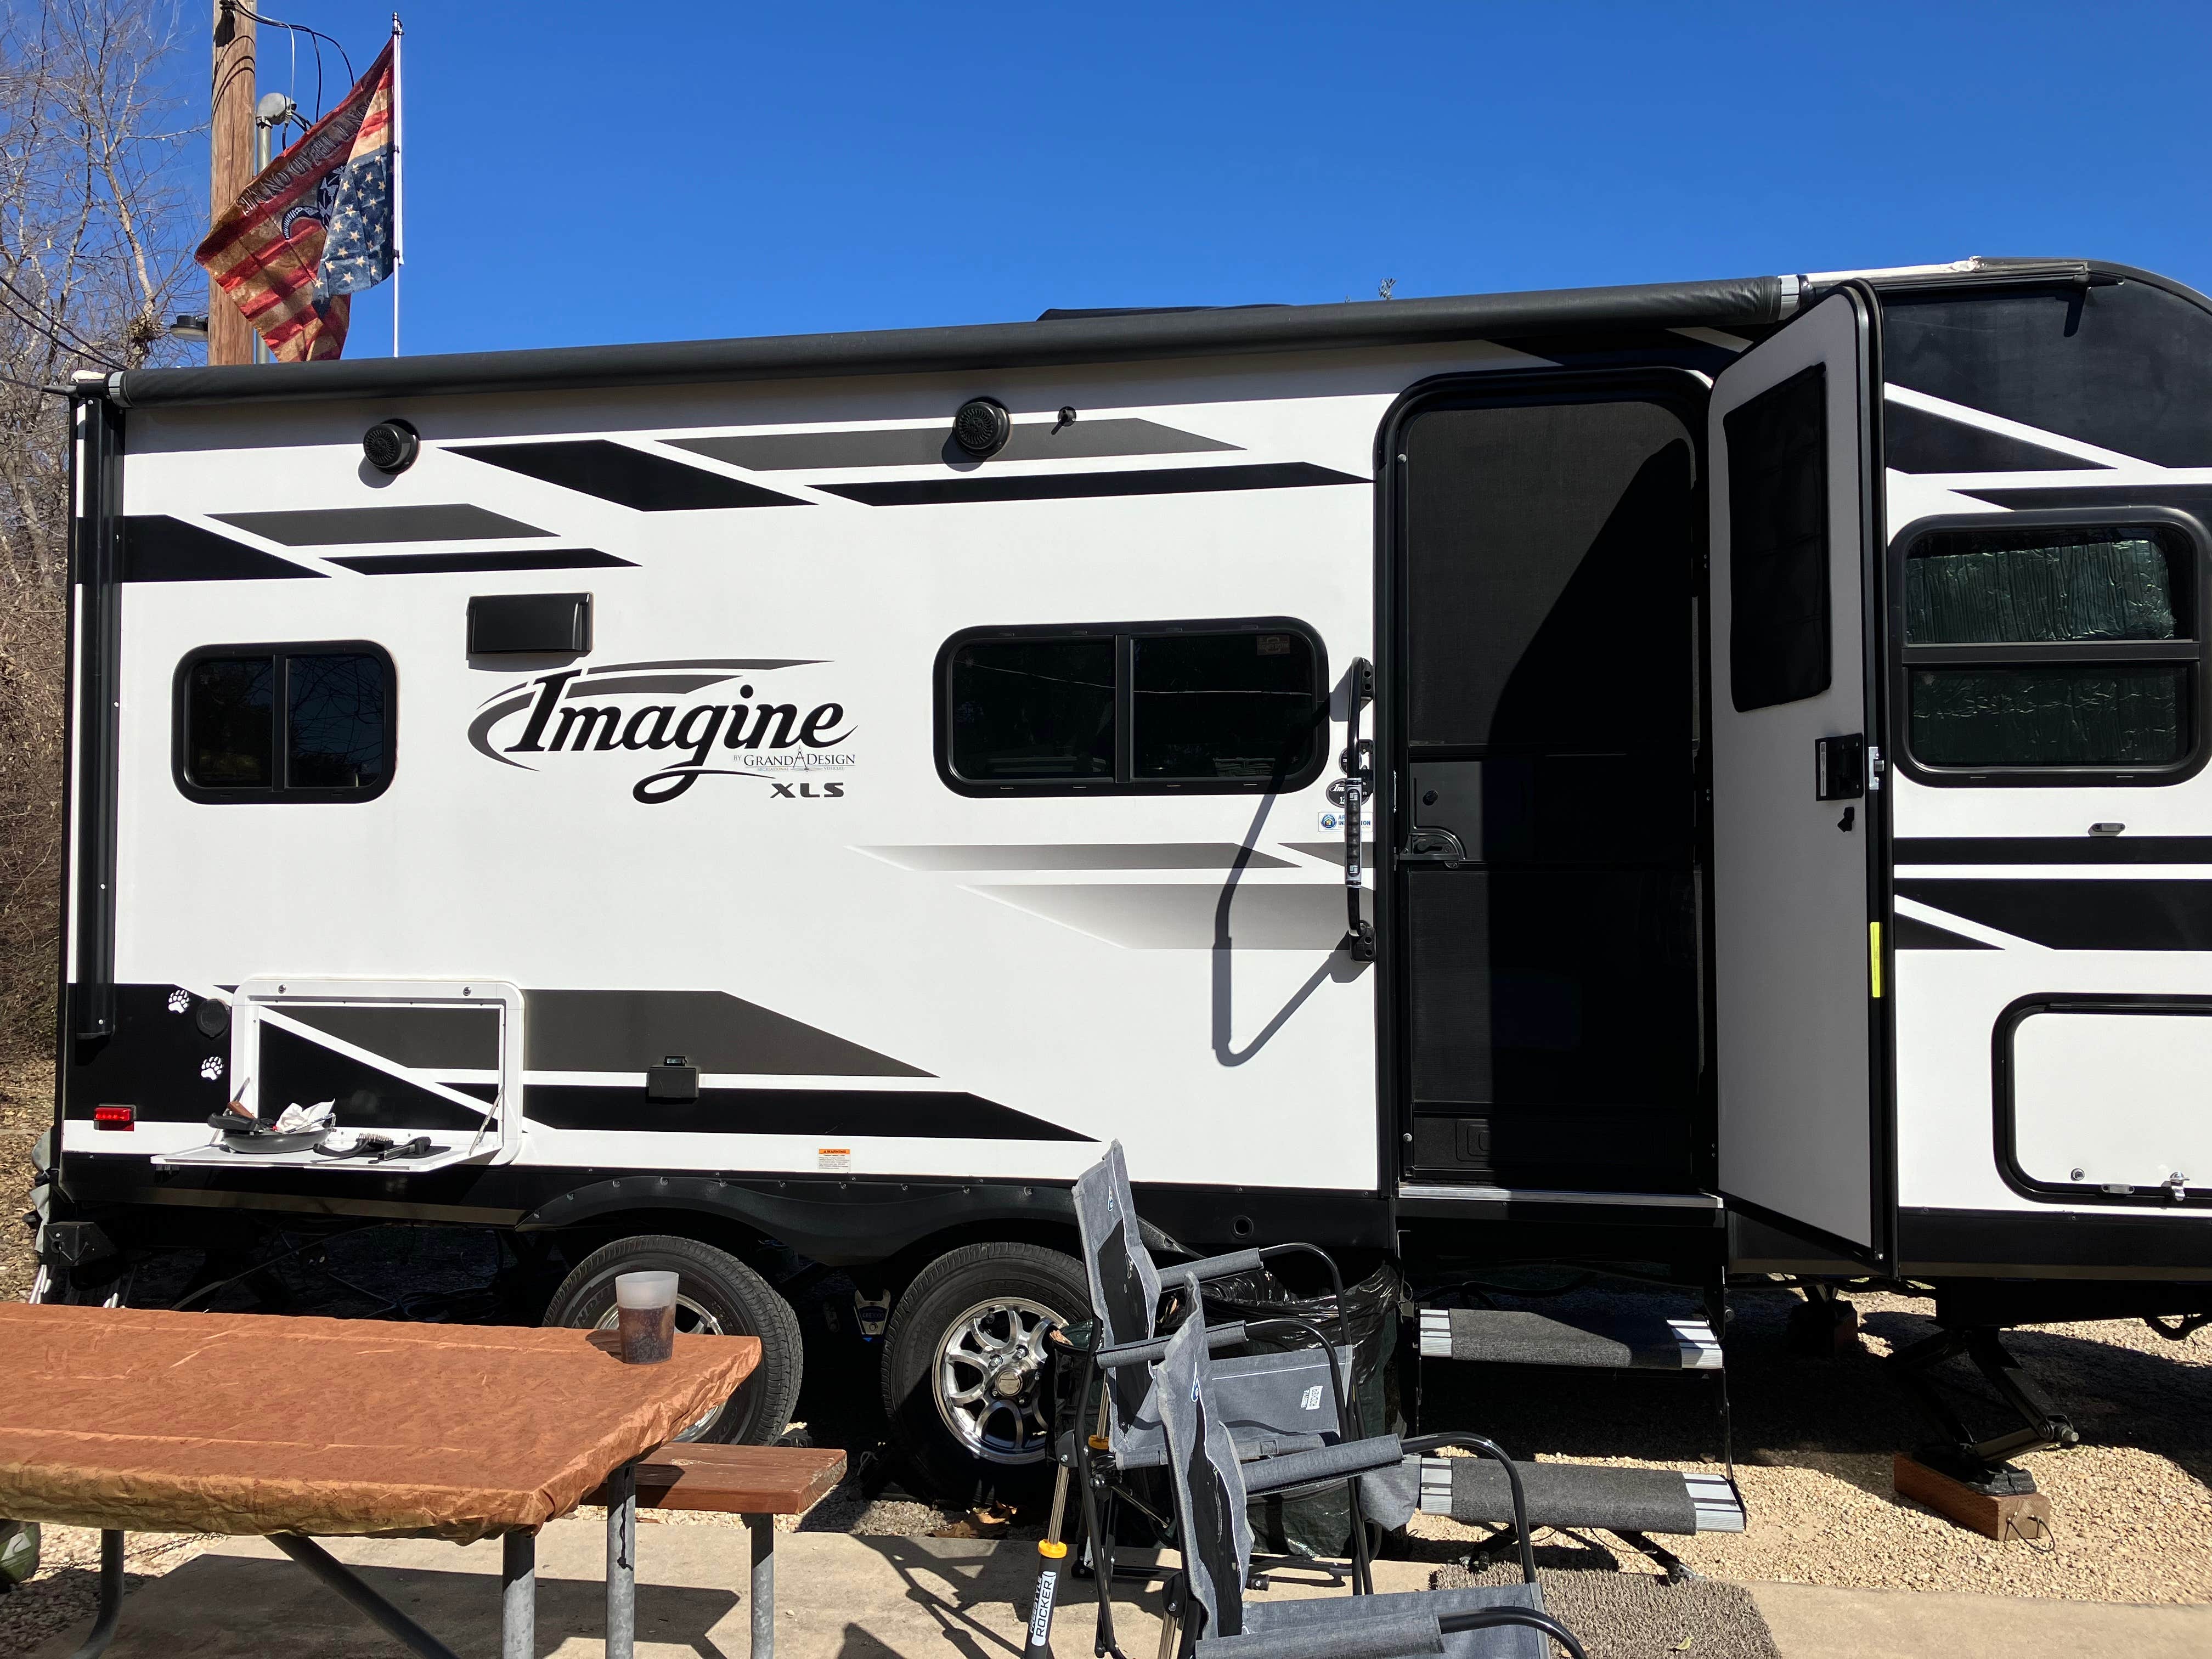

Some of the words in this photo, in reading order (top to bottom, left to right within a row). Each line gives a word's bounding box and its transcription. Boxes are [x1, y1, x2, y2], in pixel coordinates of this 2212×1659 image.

[264, 171, 291, 195] ON
[504, 669, 858, 804] Imagine
[744, 754, 793, 766] GRAND
[806, 753, 855, 765] DESIGN
[770, 782, 844, 799] XLS
[1036, 1580, 1053, 1638] ROCKER
